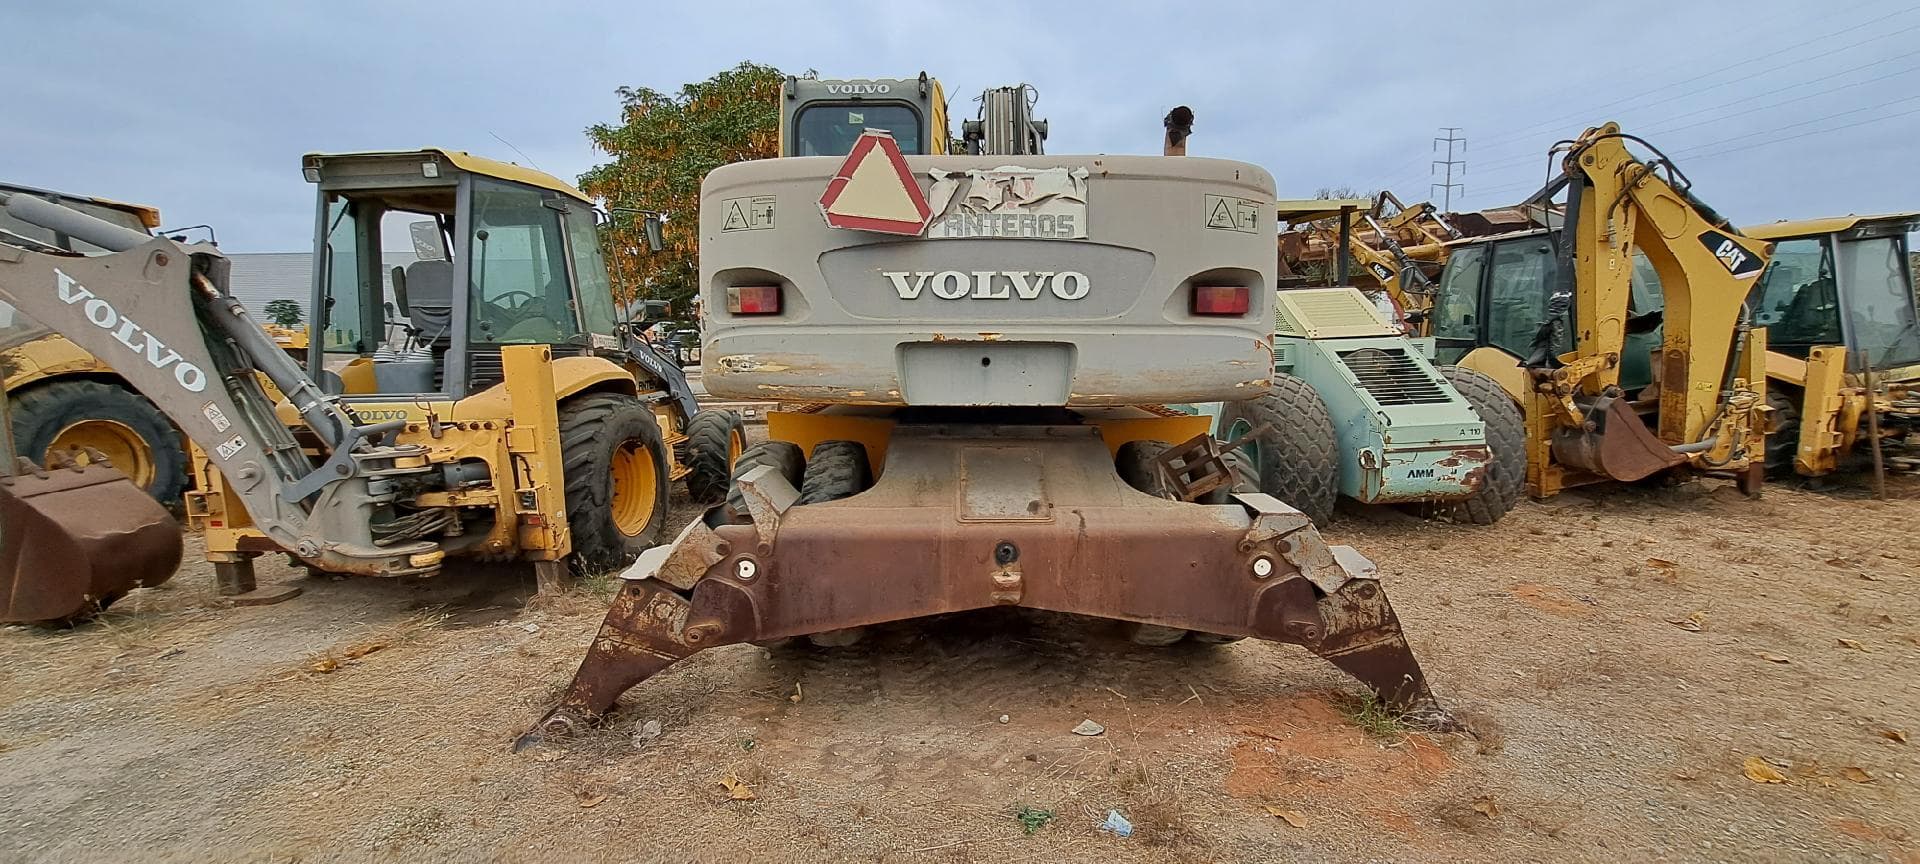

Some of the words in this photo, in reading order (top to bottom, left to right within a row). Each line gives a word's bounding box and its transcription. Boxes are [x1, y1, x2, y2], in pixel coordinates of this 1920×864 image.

[826, 84, 890, 94] VOLVO
[944, 213, 1075, 237] ANTEROS
[1715, 239, 1747, 273] CAT
[882, 270, 1091, 300] VOLVO
[53, 267, 207, 393] VOLVO
